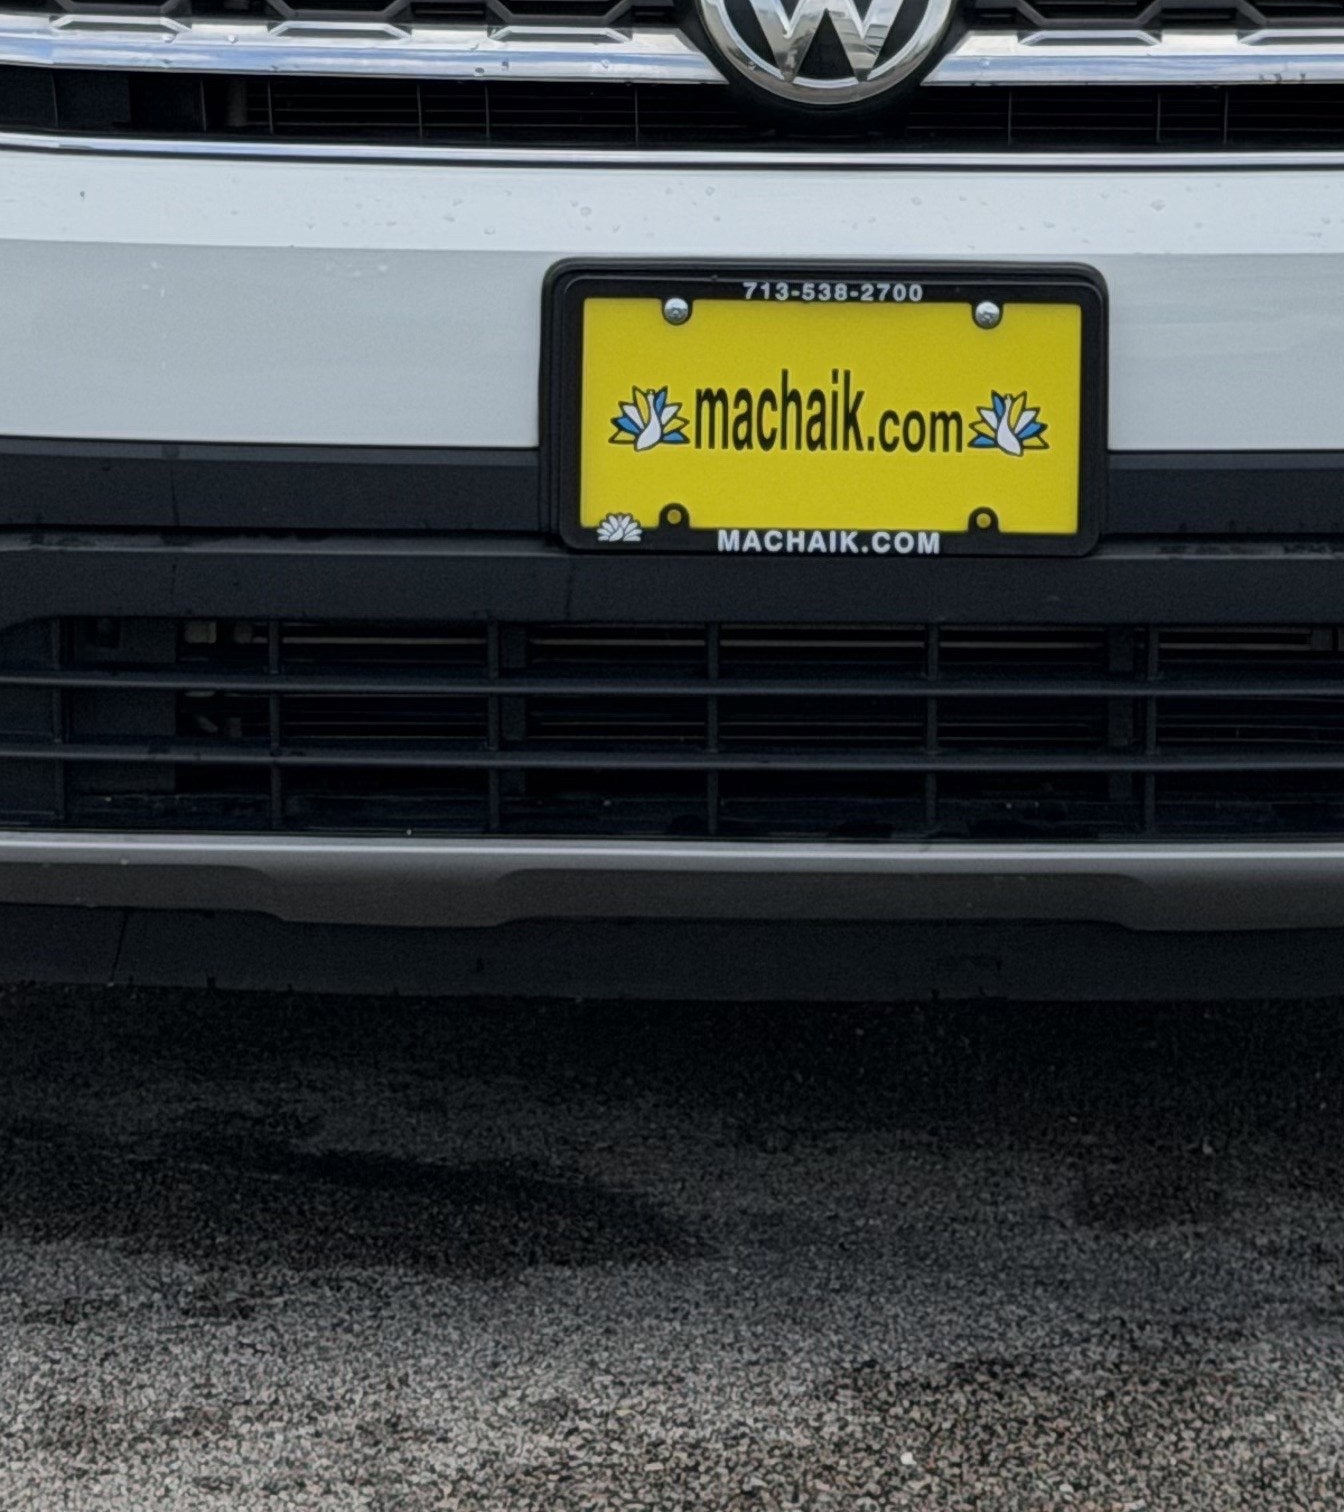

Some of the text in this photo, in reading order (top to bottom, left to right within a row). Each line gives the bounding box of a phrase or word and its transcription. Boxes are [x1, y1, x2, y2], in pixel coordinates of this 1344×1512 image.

[743, 283, 923, 301] 713-538-2700
[694, 368, 963, 452] machaik.com
[718, 530, 940, 554] MACHAIK.COM
